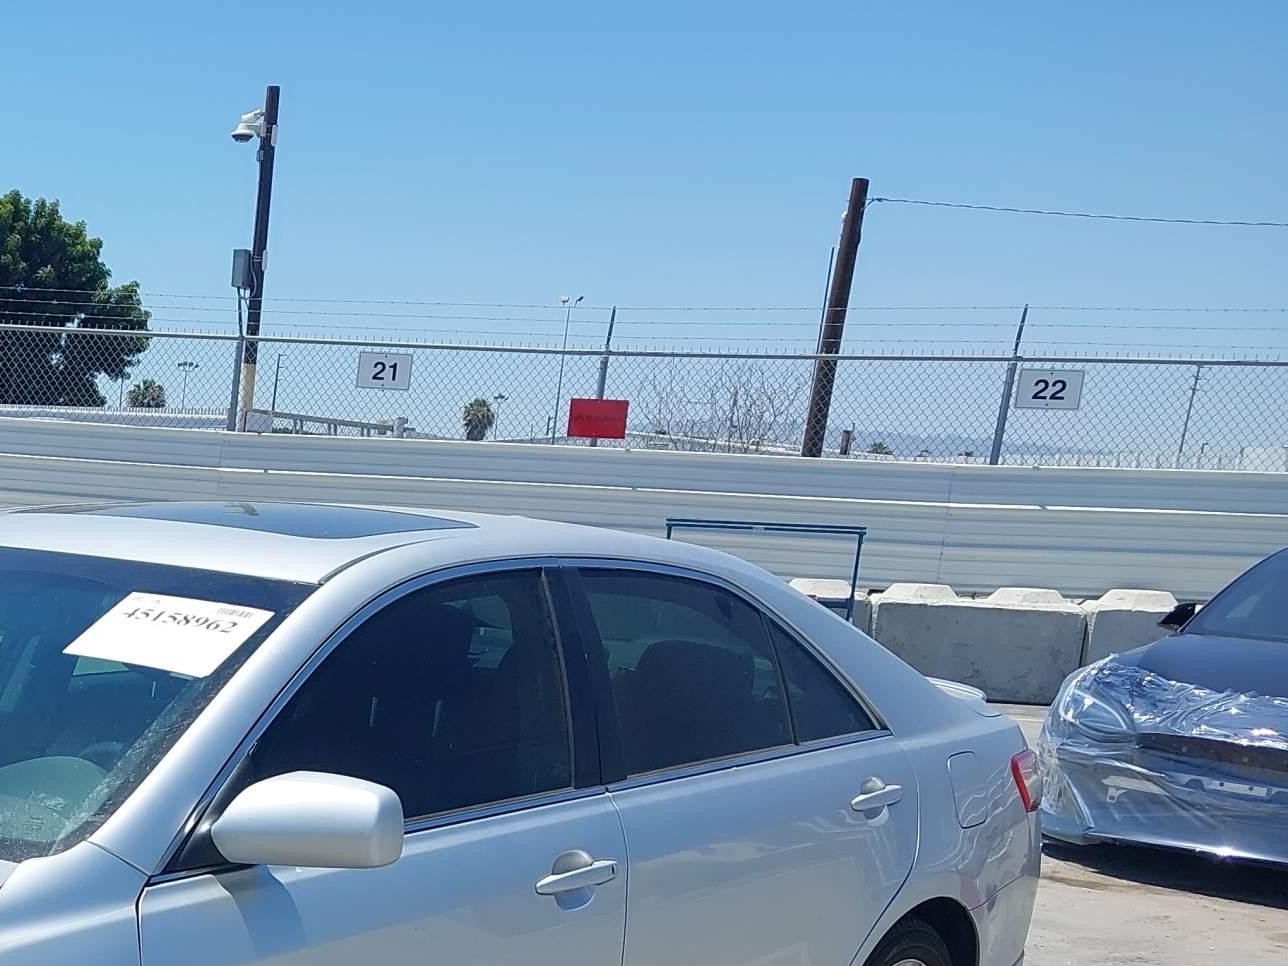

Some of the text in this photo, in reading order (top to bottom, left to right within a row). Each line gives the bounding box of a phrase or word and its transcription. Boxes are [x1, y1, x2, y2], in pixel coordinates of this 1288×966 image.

[371, 361, 399, 382] 21
[1031, 378, 1068, 401] 22
[122, 606, 239, 634] 45158962
